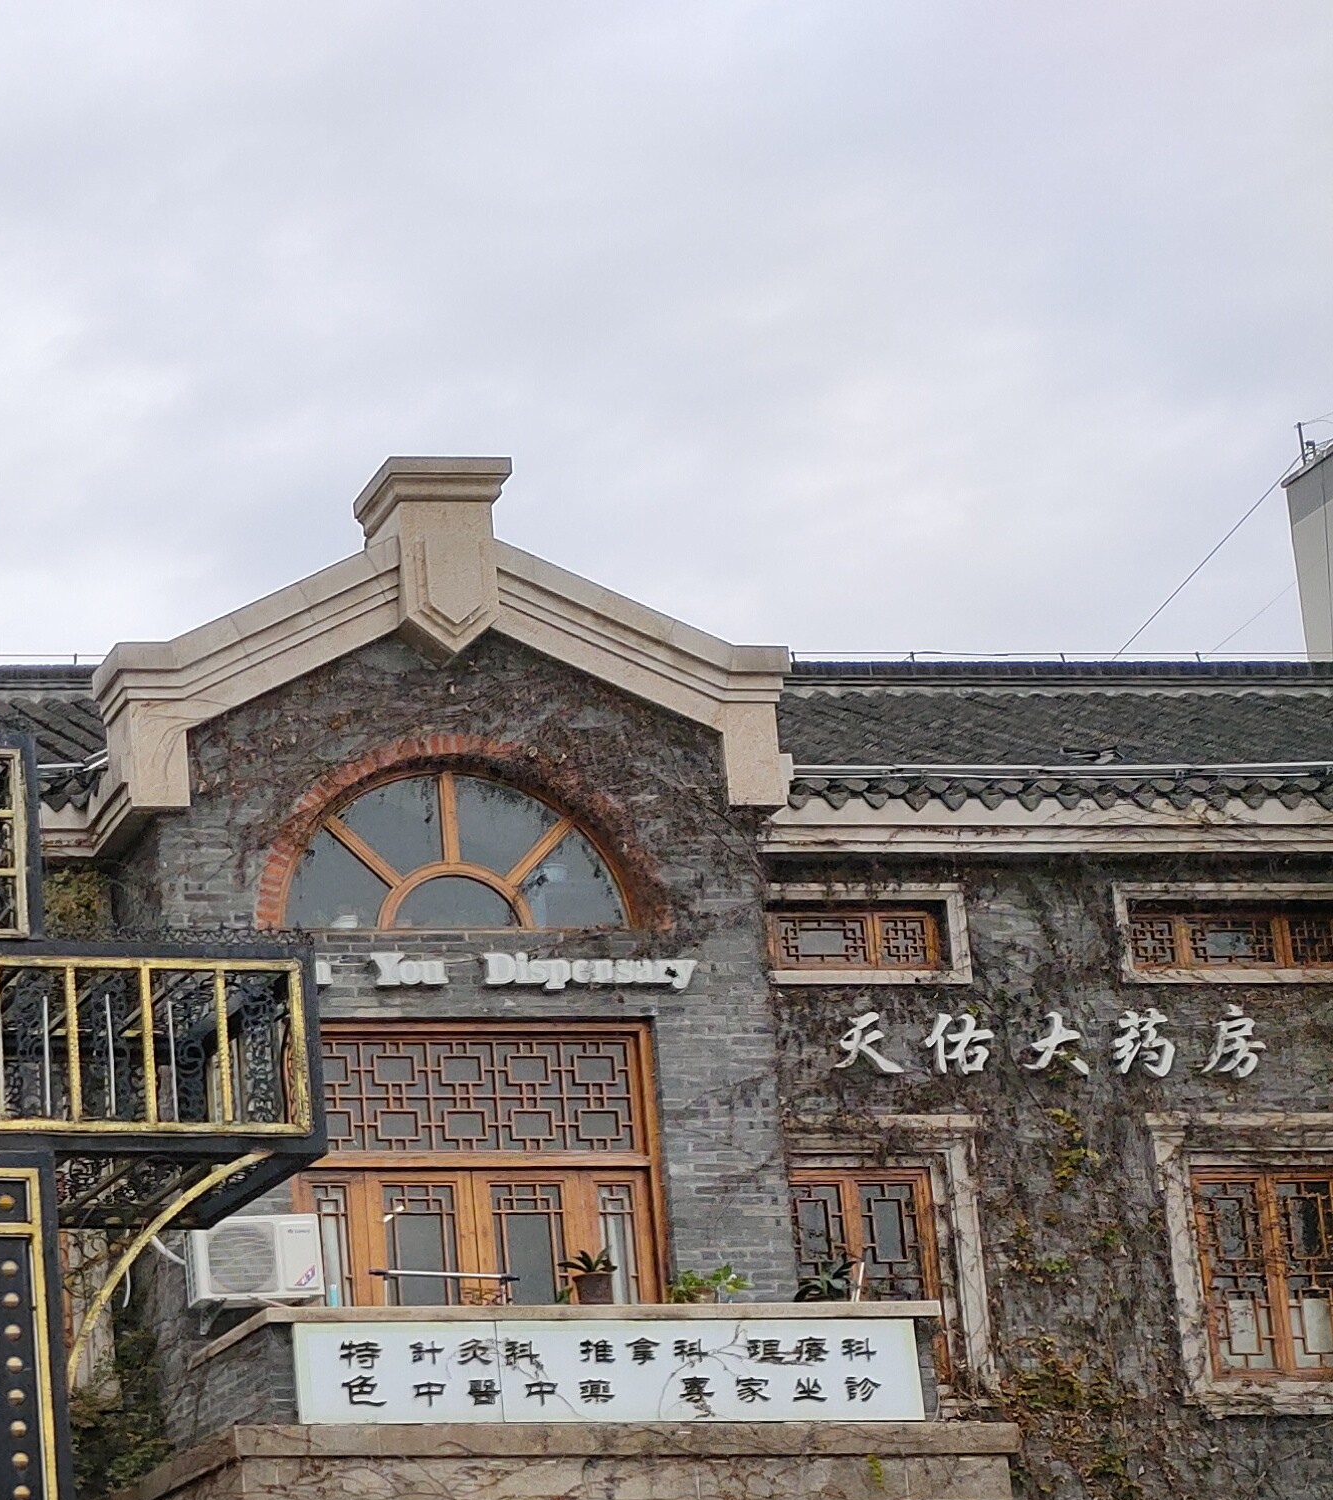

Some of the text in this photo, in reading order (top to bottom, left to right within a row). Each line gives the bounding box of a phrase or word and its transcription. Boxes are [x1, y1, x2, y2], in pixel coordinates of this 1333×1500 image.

[370, 952, 450, 986] You
[482, 952, 698, 990] Dispensary
[834, 1004, 1267, 1078] 天佑大药房
